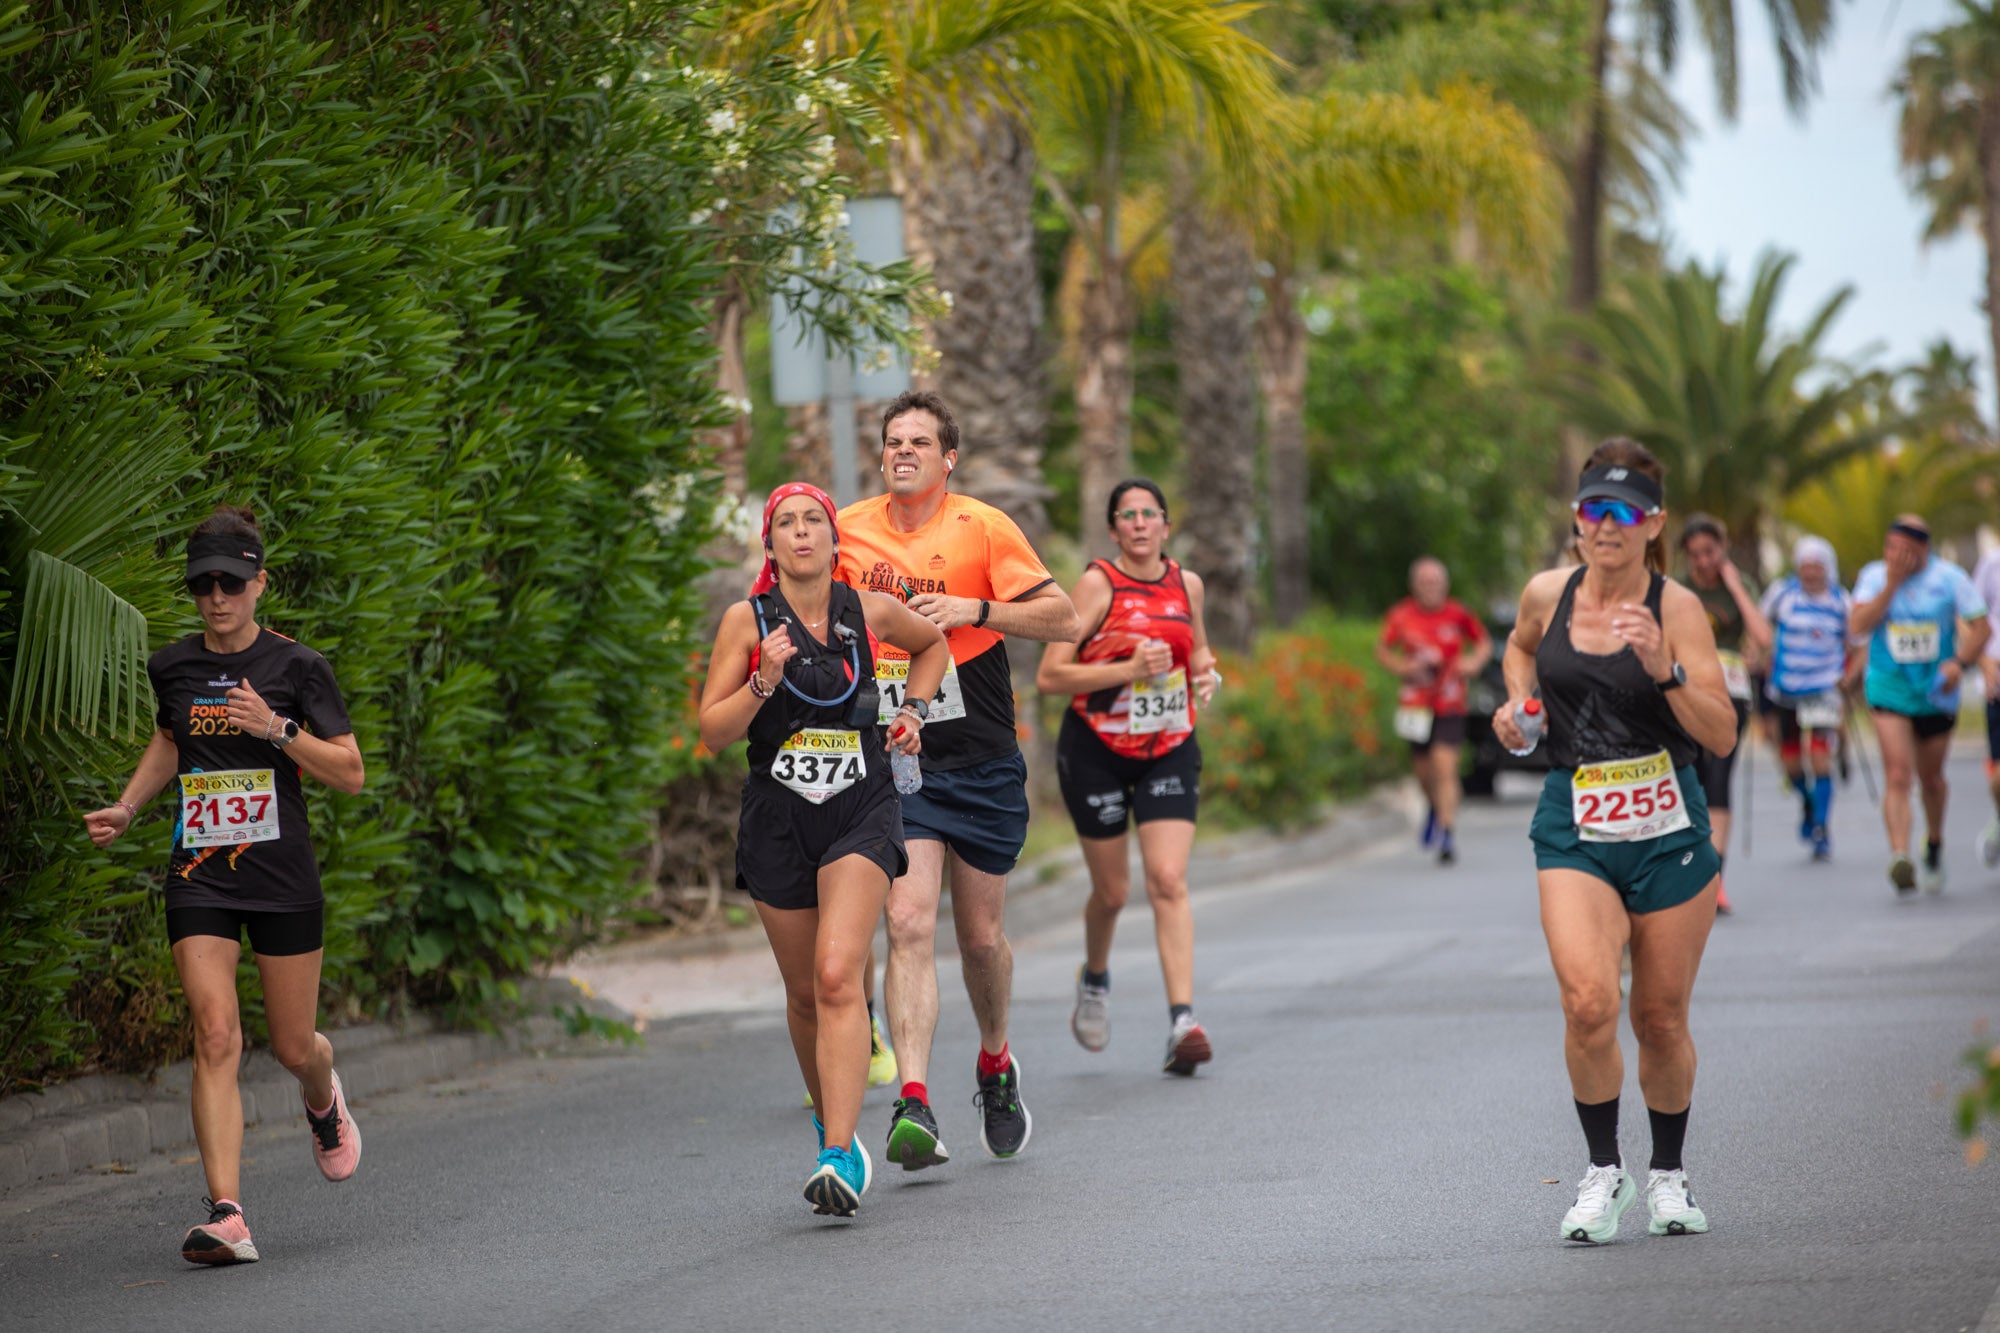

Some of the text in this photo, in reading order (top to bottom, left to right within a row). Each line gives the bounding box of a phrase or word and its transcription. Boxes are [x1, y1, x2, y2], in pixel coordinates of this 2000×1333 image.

[861, 571, 894, 587] XXXII
[884, 652, 911, 660] dataco
[881, 664, 891, 675] 38
[190, 705, 230, 717] FOND
[775, 754, 863, 785] 3374
[1586, 768, 1602, 782] 38
[193, 777, 205, 790] 38
[1579, 779, 1677, 825] 2255
[187, 794, 271, 828] 2137
